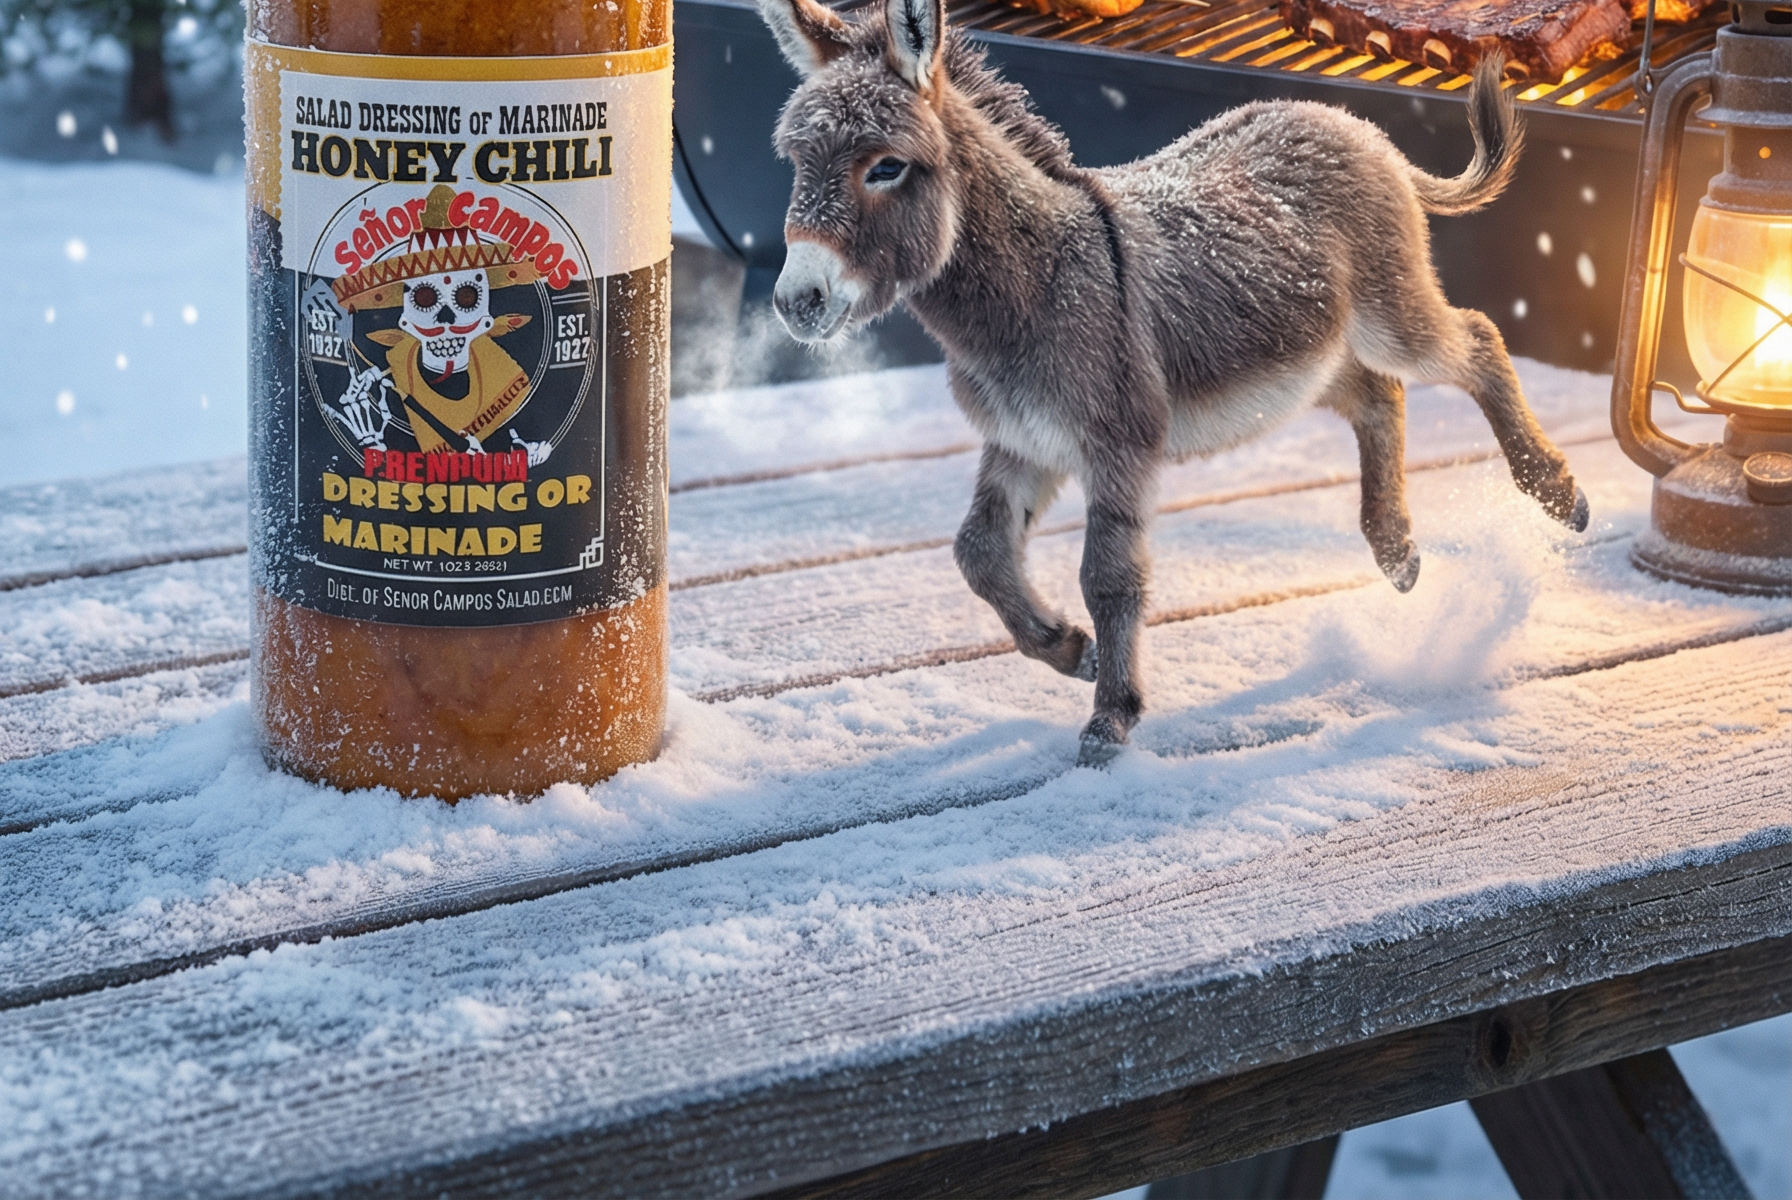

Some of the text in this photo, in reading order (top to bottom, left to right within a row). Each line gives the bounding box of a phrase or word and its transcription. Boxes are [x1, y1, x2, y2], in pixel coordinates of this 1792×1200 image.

[296, 96, 607, 135] SALAD DRESSING OF MARINADE
[290, 130, 613, 184] HONEY CHILI
[557, 313, 588, 338] EST.
[322, 472, 592, 513] DRESSING OR
[322, 514, 543, 556] MARINADE
[383, 558, 409, 571] NET
[412, 560, 433, 572] WT
